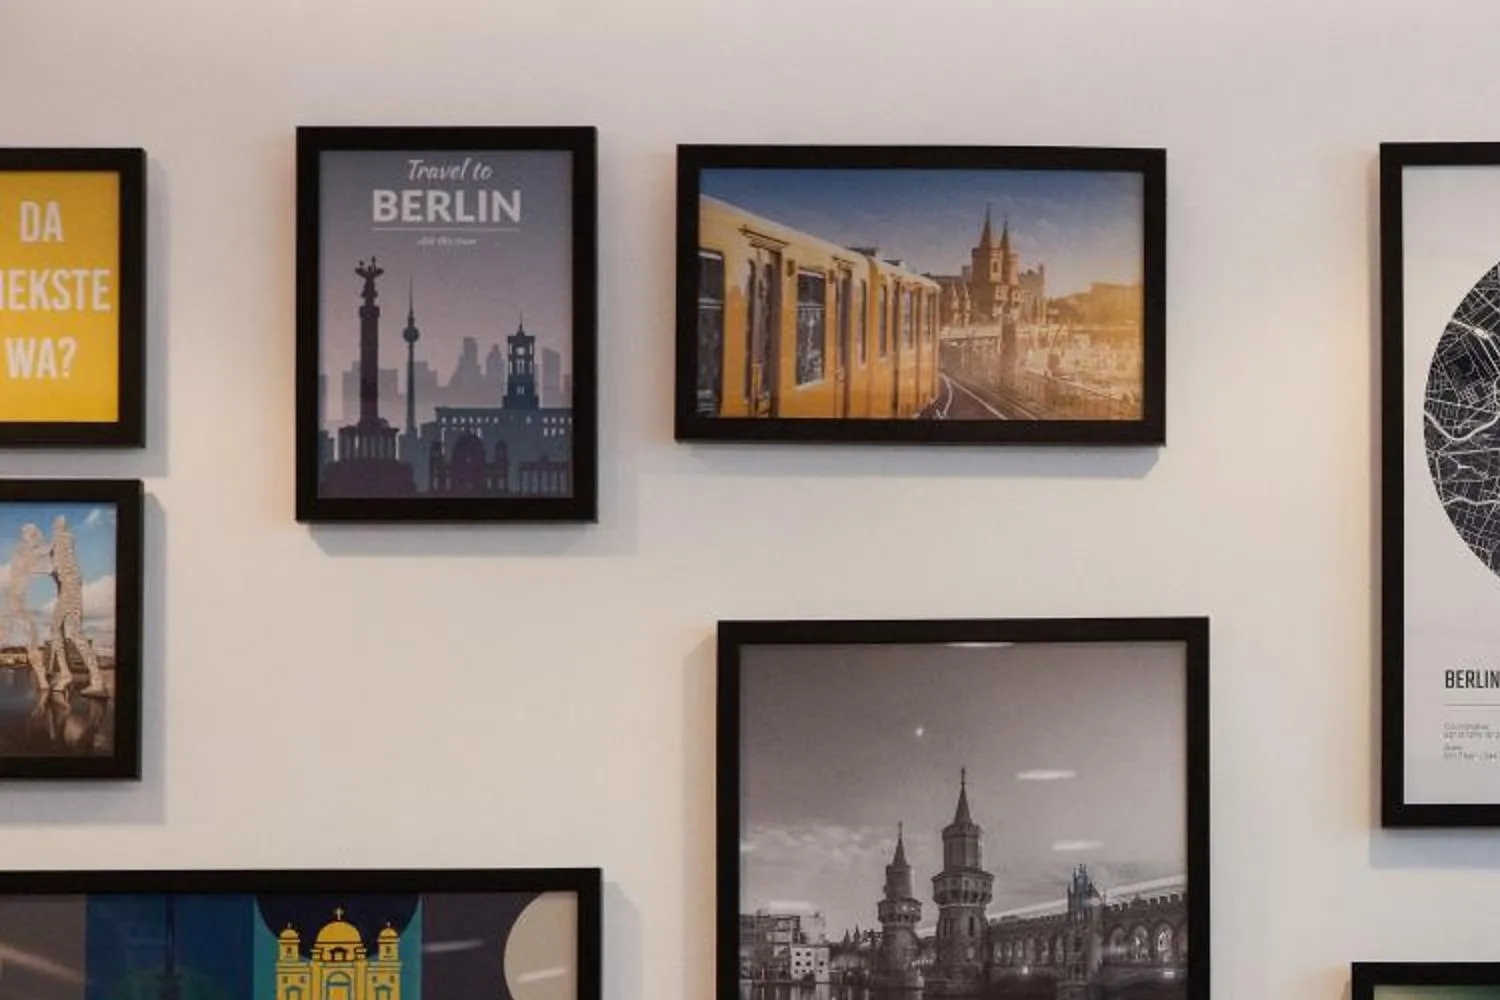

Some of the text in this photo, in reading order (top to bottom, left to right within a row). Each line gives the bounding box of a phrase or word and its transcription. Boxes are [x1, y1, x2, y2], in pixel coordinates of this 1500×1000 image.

[408, 157, 494, 181] Travel to
[20, 200, 64, 243] DA
[372, 188, 521, 223] BERLIN
[5, 335, 78, 380] WA?
[1445, 669, 1500, 689] BERLIN
